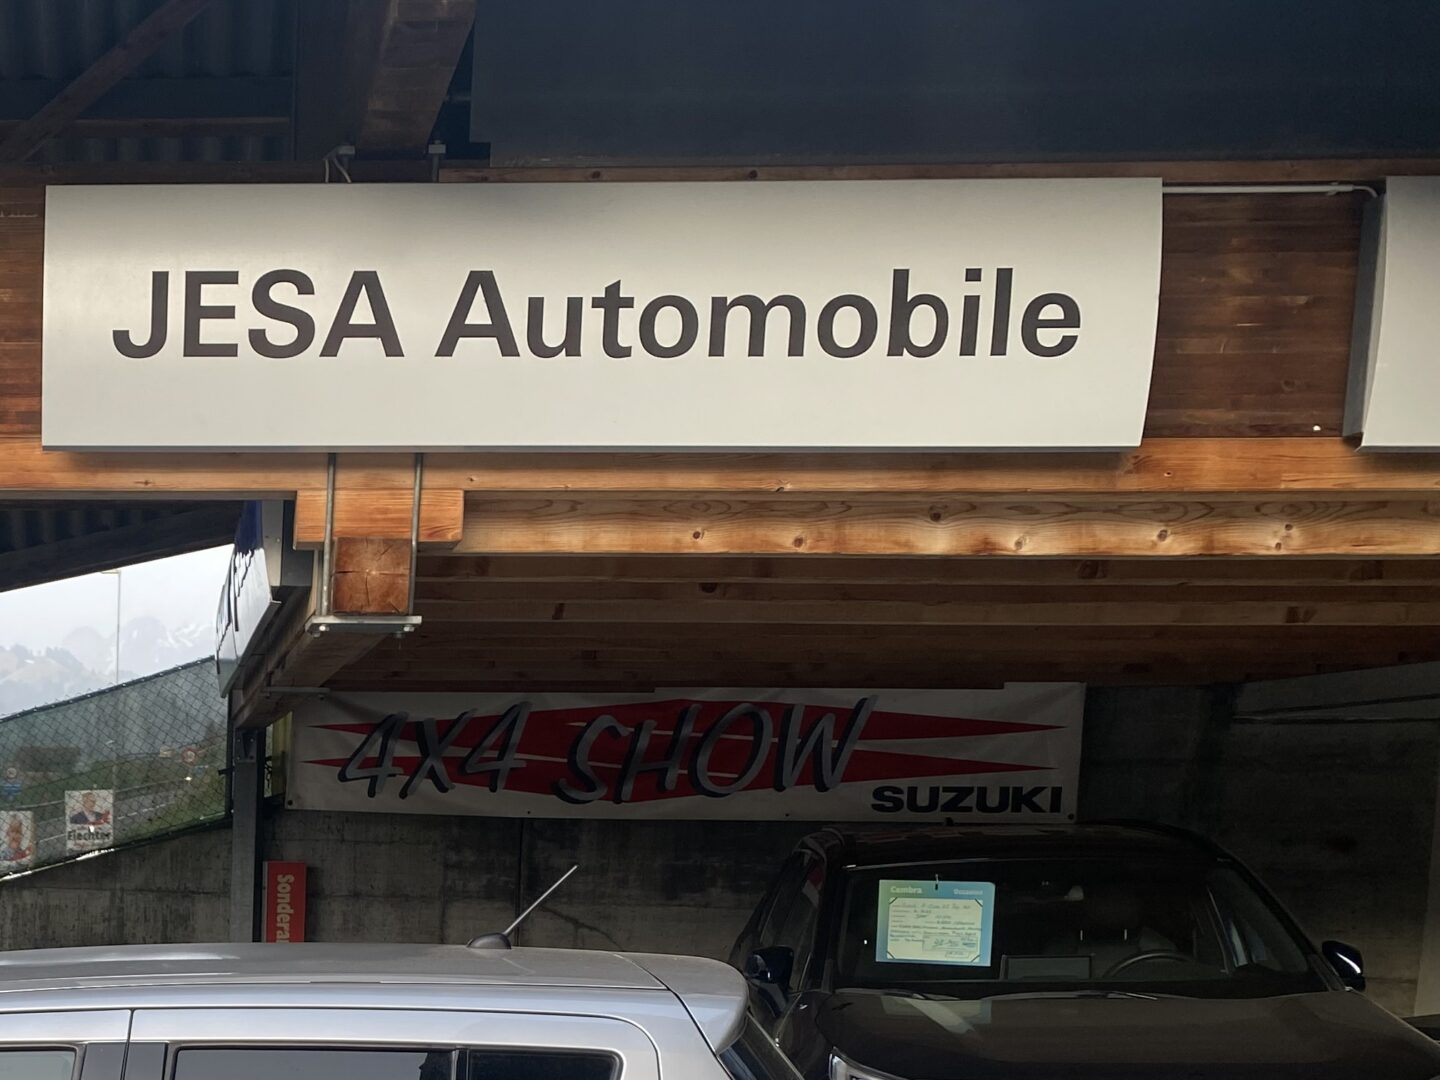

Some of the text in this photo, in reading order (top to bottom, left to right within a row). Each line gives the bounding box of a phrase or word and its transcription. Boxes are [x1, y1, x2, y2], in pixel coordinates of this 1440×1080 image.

[111, 267, 1082, 360] JESA Automobile
[550, 695, 879, 804] SHOW
[870, 784, 1064, 815] SUZUKI
